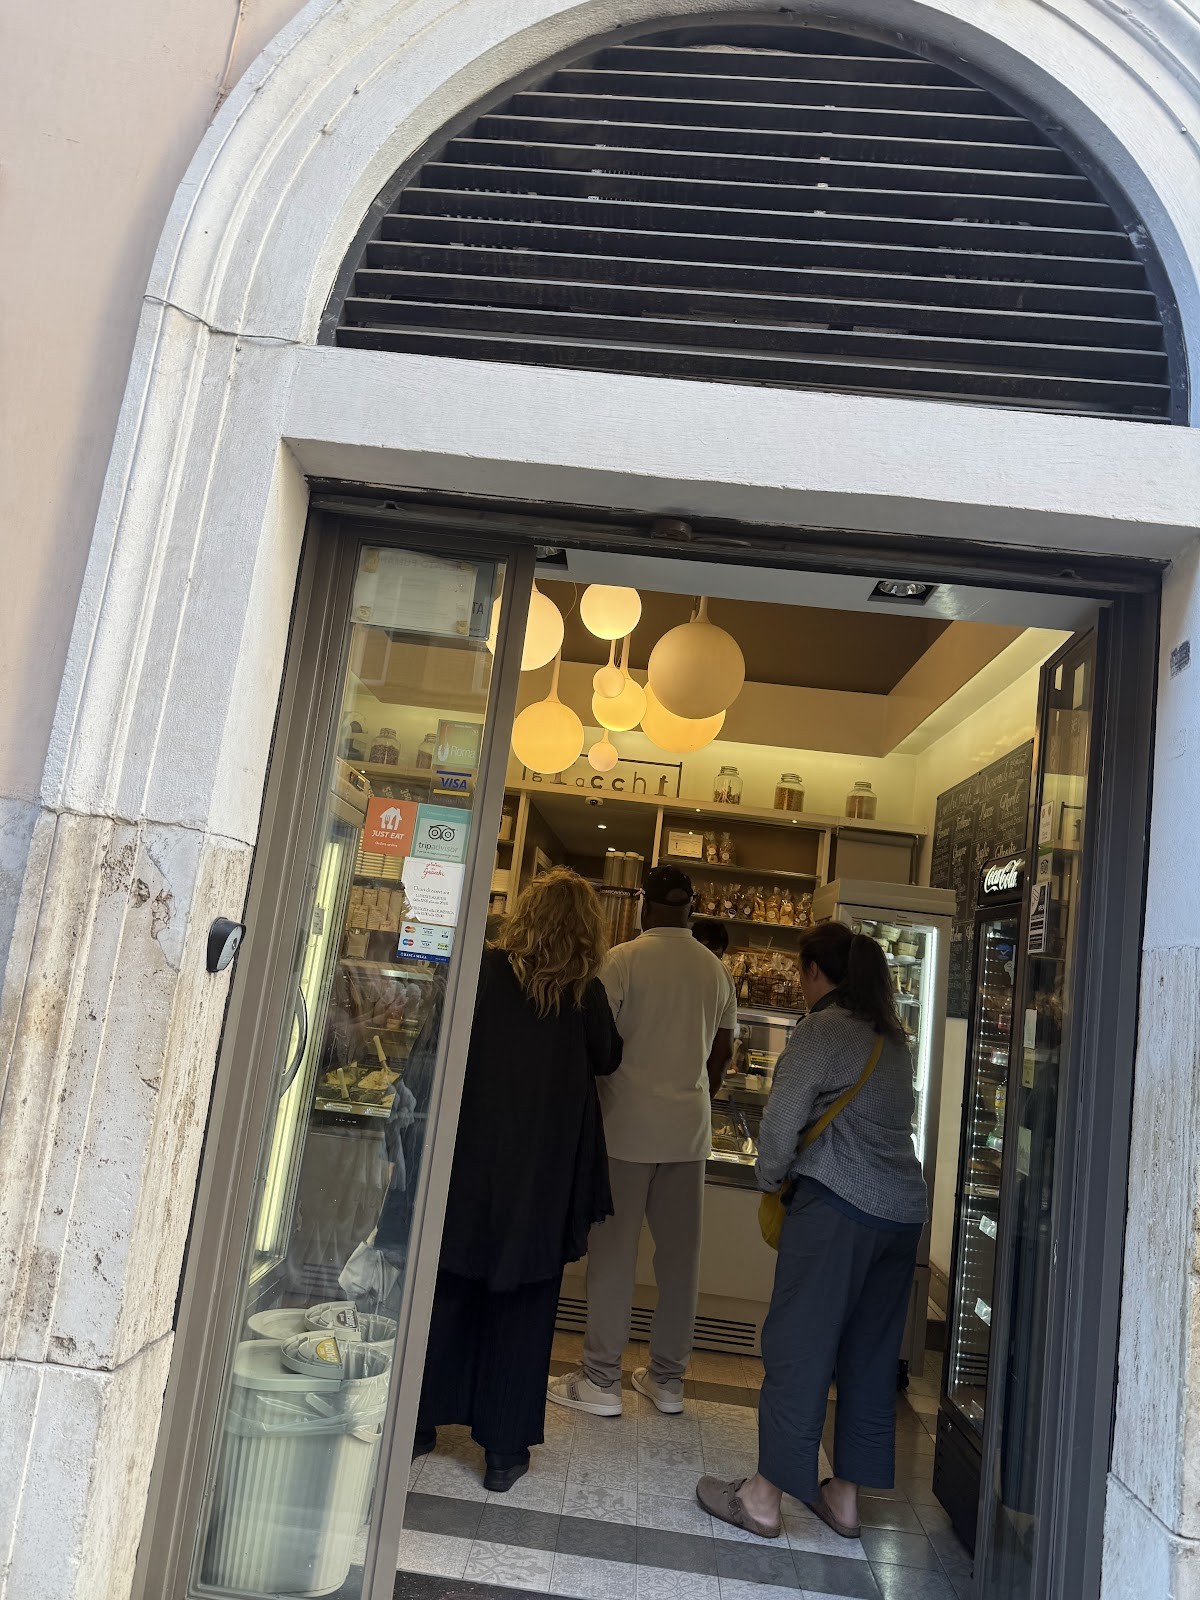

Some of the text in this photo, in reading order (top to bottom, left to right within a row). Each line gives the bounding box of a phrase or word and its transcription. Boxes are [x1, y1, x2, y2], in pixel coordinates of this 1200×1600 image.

[441, 777, 467, 789] VISA
[372, 829, 404, 840] JUST EAT
[418, 841, 459, 854] tripadvisor
